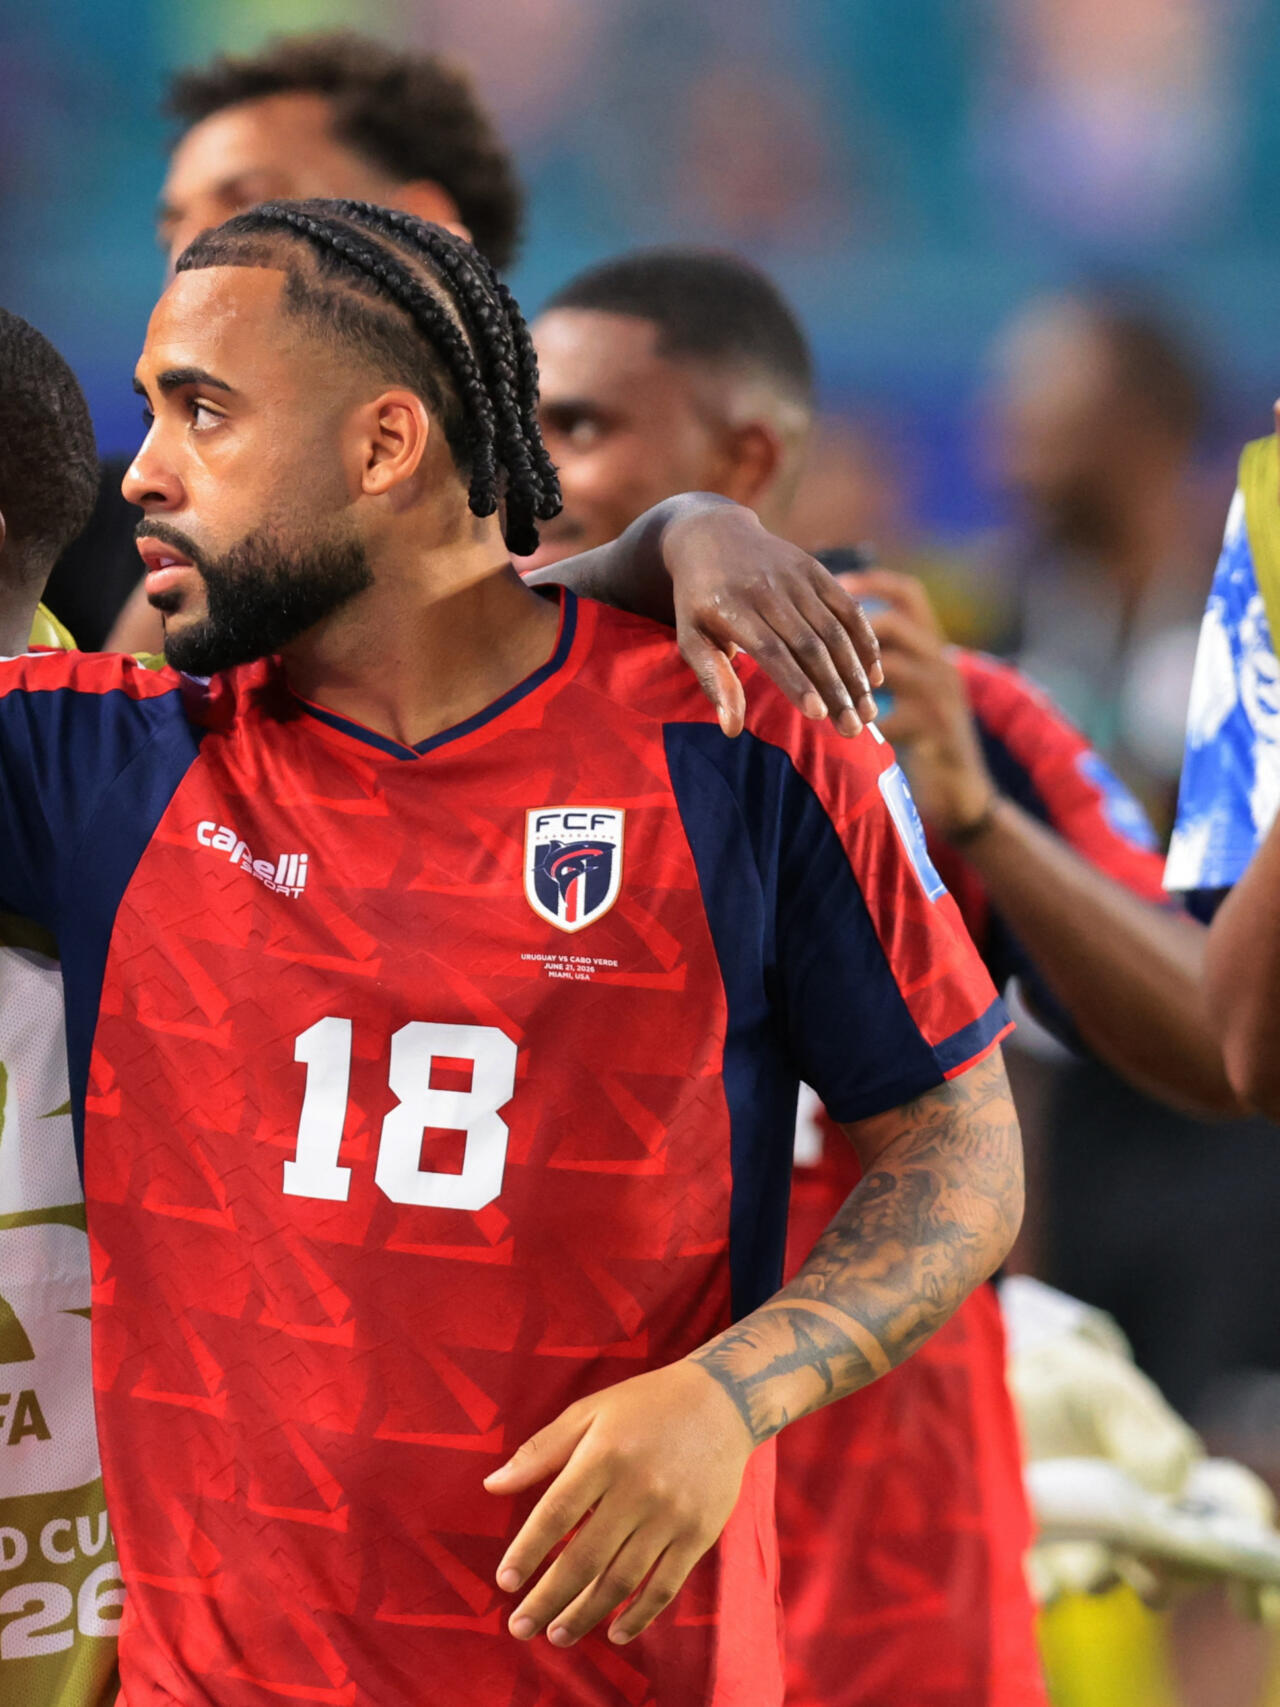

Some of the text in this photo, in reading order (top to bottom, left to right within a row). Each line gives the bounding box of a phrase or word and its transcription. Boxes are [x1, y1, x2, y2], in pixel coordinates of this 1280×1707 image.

[536, 813, 616, 832] FCF
[570, 956, 592, 964] CABO
[593, 958, 618, 967] VERDE
[548, 971, 574, 979] MIAMI,
[282, 1016, 518, 1211] 18
[40, 1510, 117, 1565] CU
